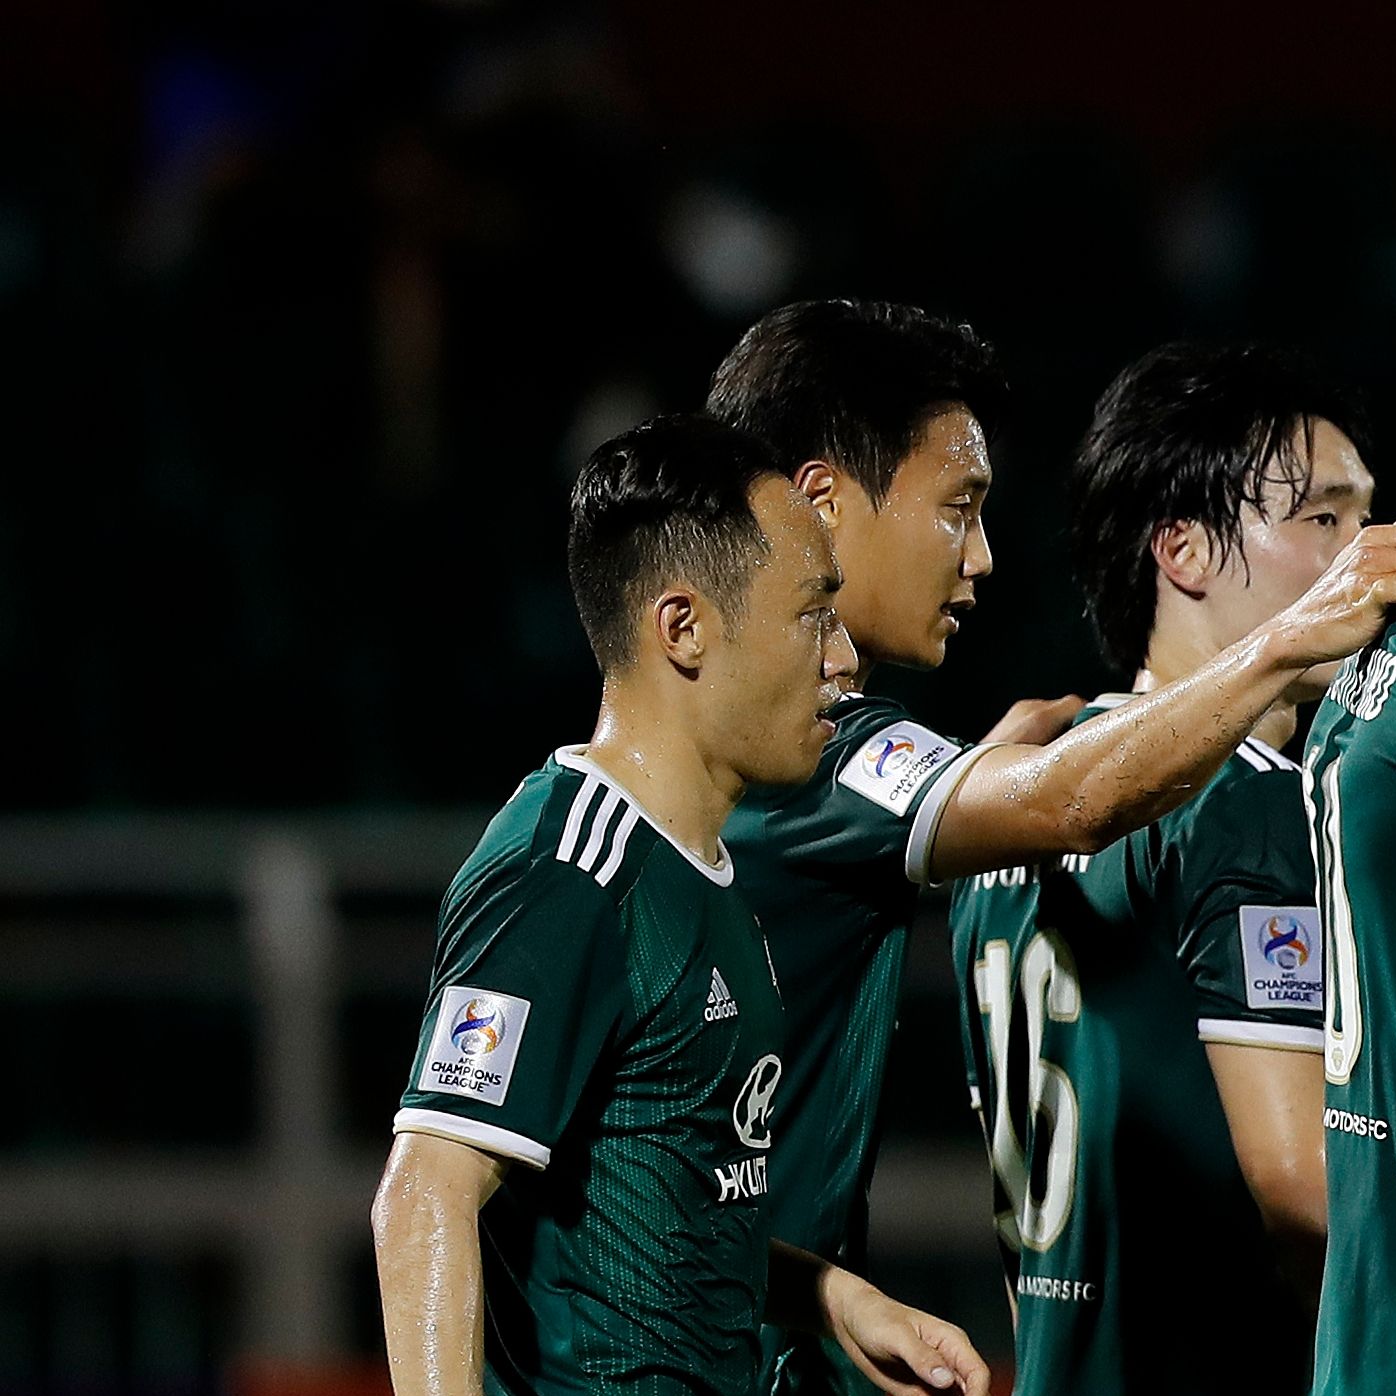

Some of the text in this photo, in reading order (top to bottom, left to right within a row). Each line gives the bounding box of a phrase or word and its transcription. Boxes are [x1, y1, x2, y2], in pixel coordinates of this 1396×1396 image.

[1254, 980, 1323, 992] CHAMPIONS
[1268, 991, 1313, 1002] LEAGUE
[431, 1061, 502, 1086] CHAMPIONS
[438, 1074, 490, 1093] LEAGUE
[974, 930, 1081, 1252] 16
[1368, 1118, 1388, 1140] FC
[1073, 1281, 1097, 1301] FC
